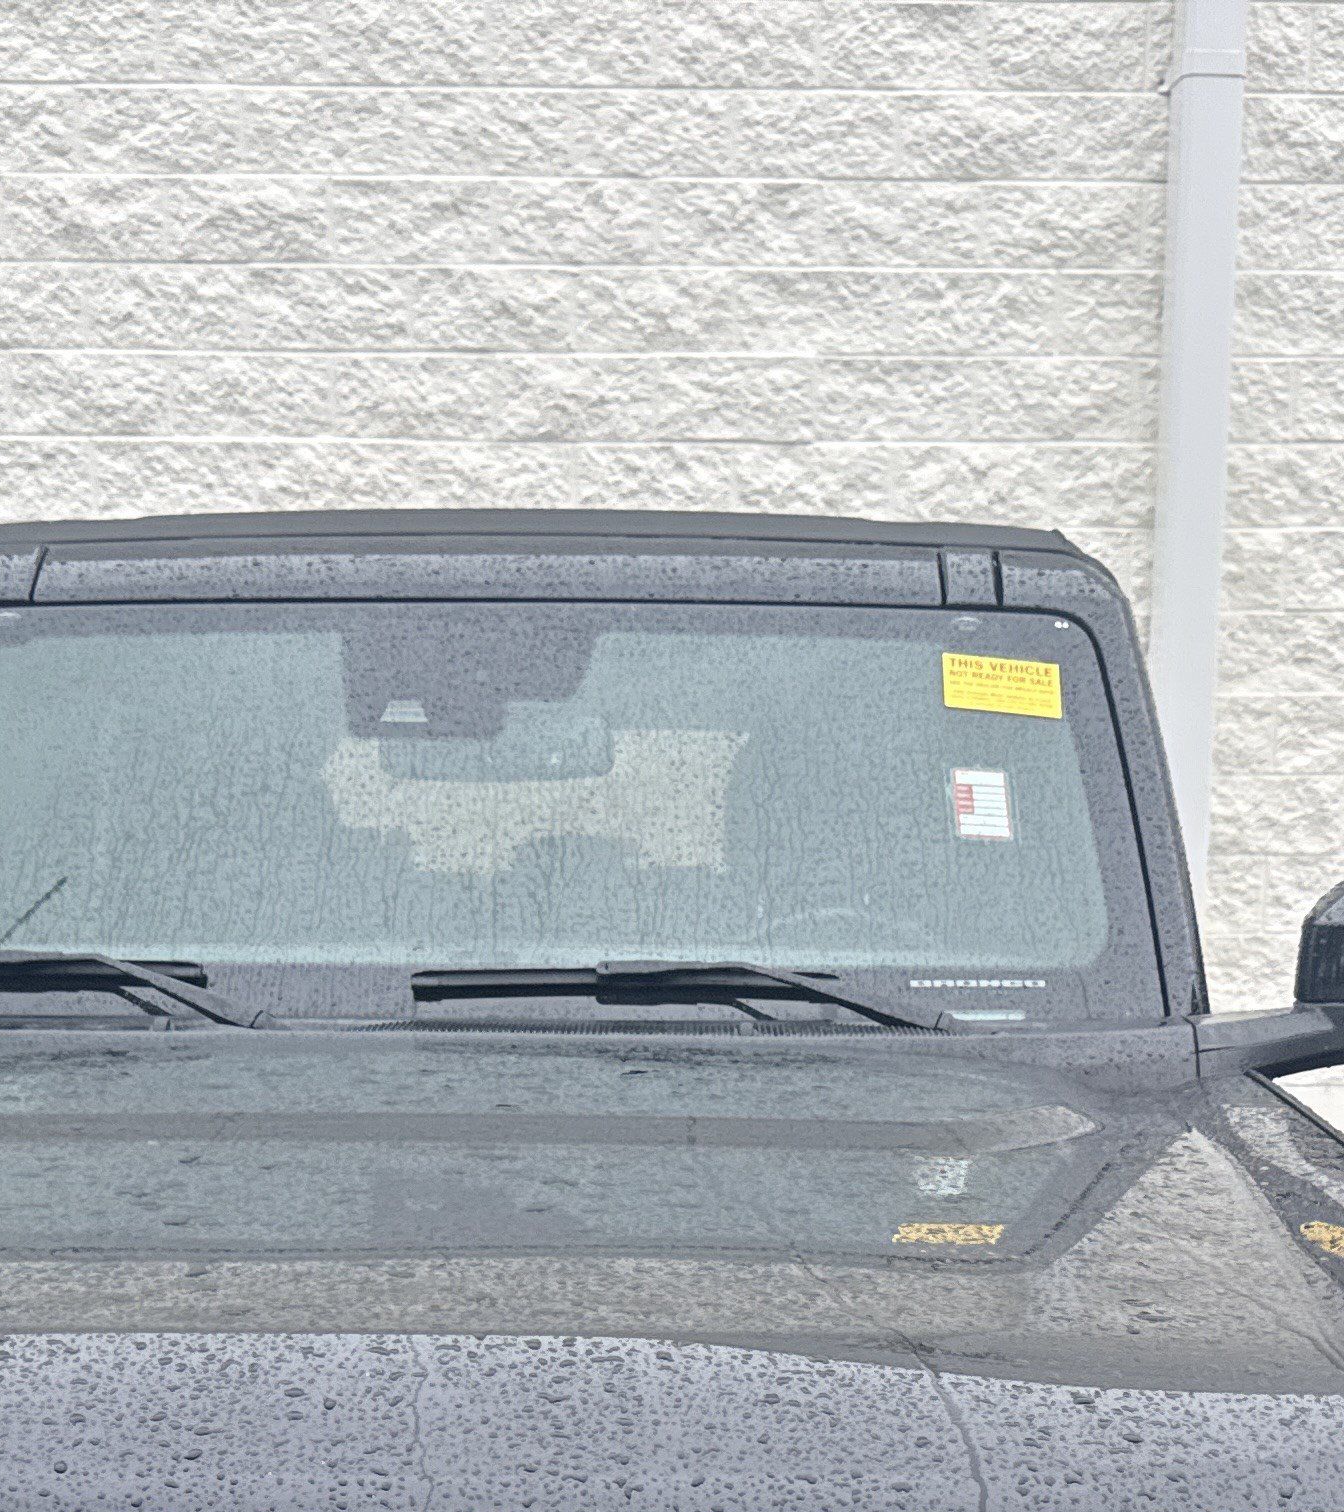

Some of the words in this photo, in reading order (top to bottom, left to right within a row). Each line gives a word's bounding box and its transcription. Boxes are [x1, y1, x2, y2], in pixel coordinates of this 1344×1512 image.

[950, 658, 983, 670] THIS
[990, 662, 1052, 677] VEHICLE
[949, 670, 968, 678] NOT
[972, 672, 1003, 681] READY
[1007, 675, 1026, 683] FOR
[1030, 677, 1053, 687] SALE
